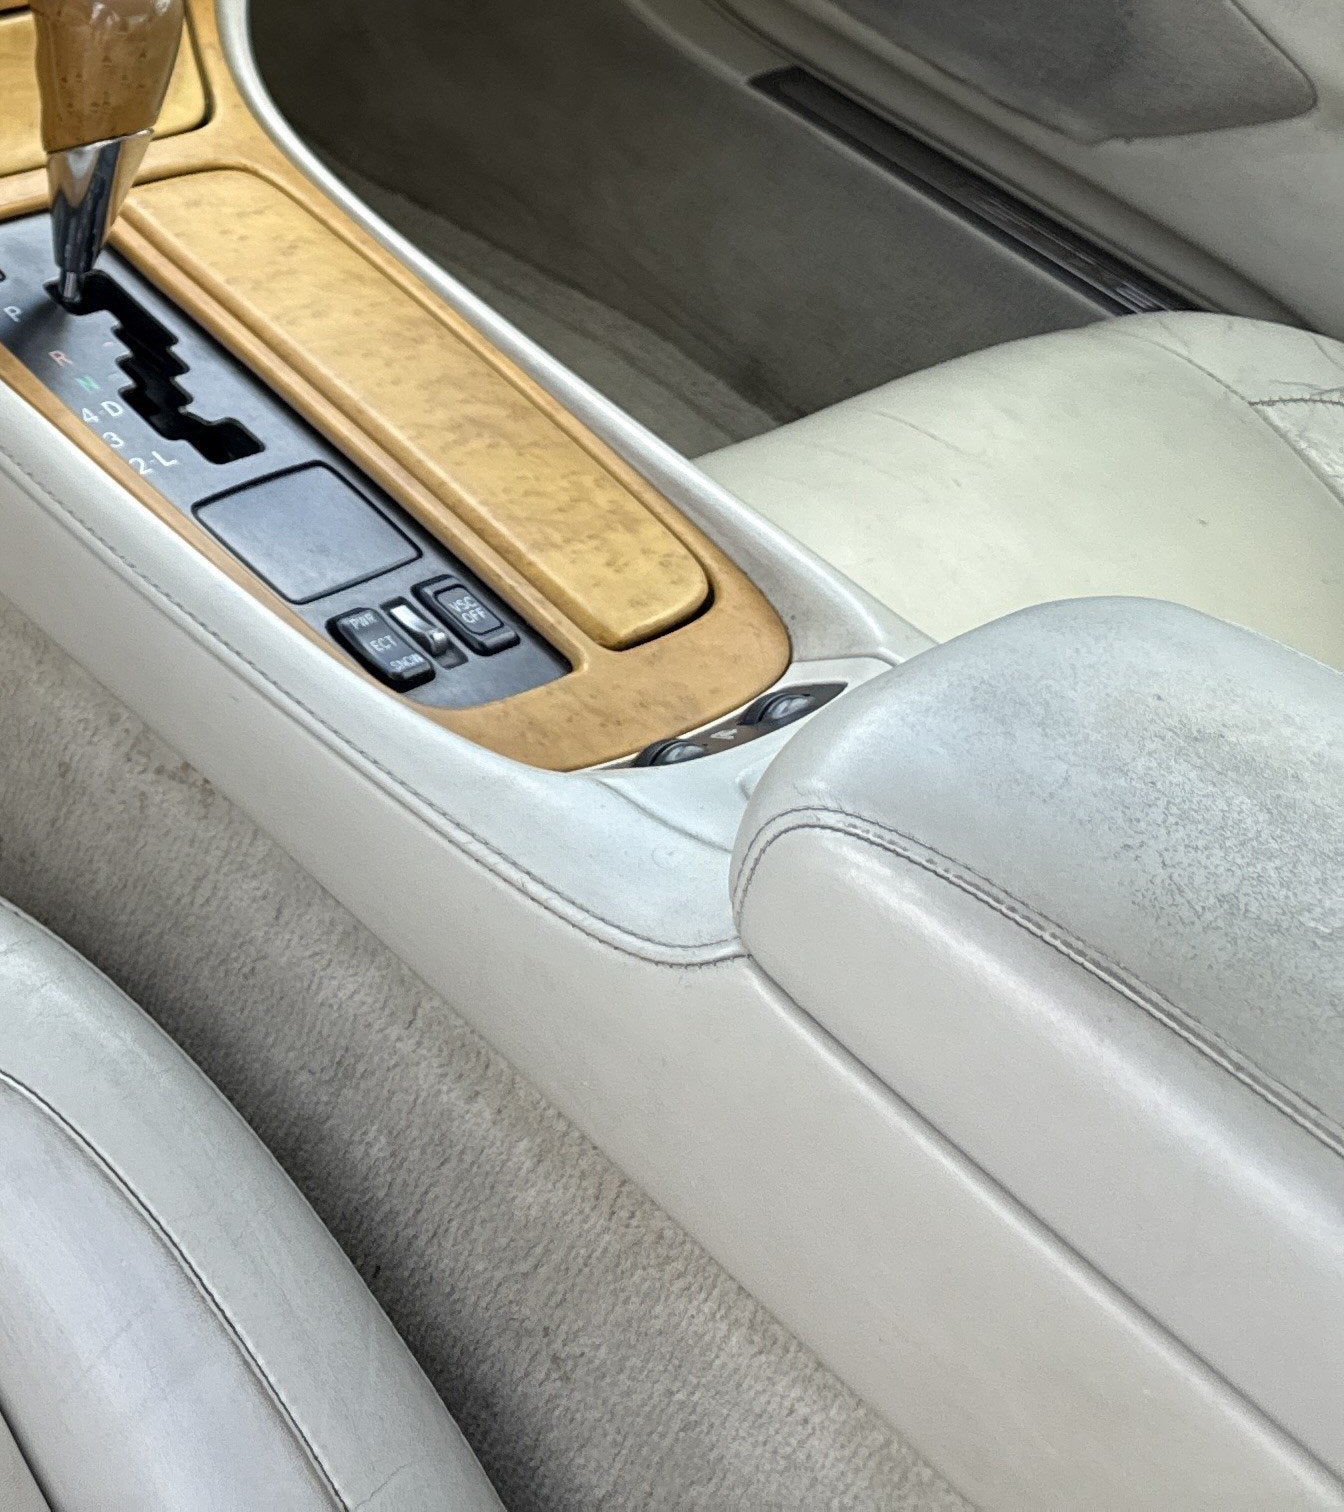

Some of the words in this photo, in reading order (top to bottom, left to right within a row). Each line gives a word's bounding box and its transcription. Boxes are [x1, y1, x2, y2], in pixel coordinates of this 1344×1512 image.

[3, 305, 22, 322] P
[48, 350, 74, 367] R
[75, 375, 101, 392] N
[102, 431, 126, 449] 3
[449, 595, 477, 613] VSC
[348, 613, 378, 630] PWR
[461, 608, 488, 624] OFF
[369, 635, 398, 653] ECT
[390, 654, 424, 671] SNOW
